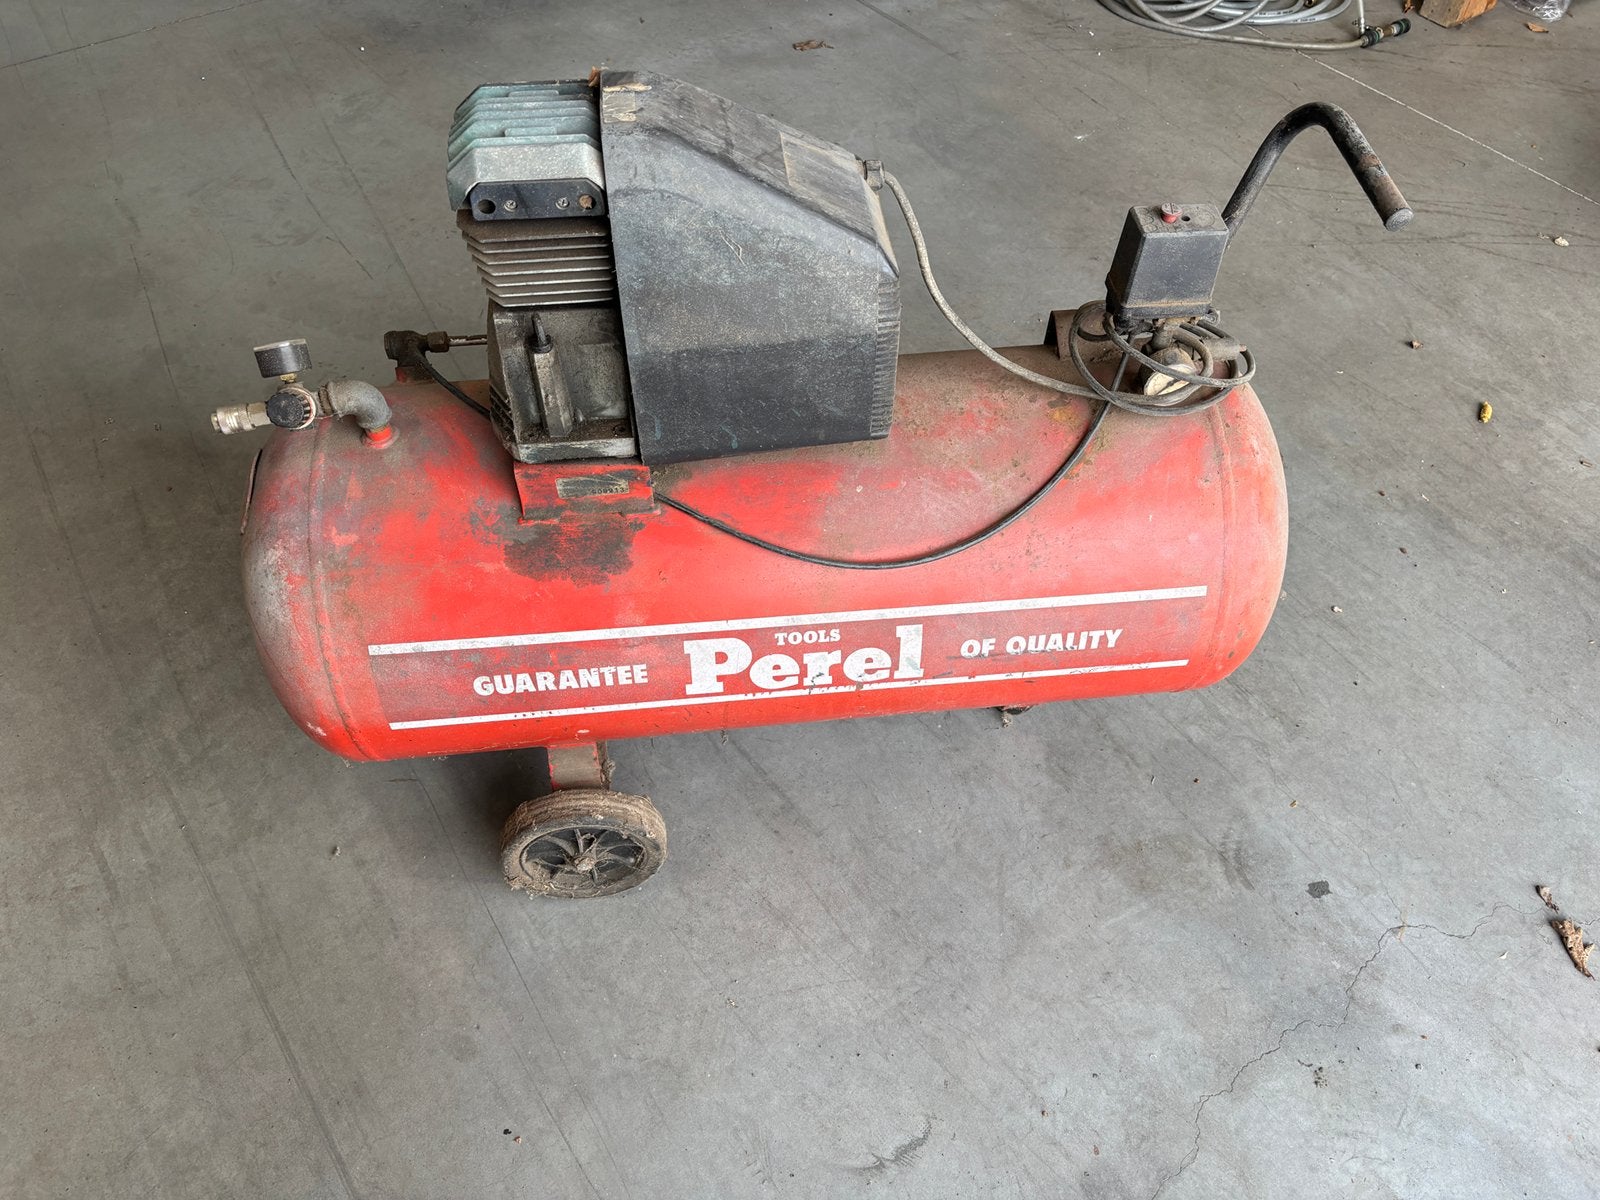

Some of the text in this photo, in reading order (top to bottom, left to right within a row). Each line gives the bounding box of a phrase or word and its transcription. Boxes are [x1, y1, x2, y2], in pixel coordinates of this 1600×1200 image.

[775, 628, 841, 647] TOOLS
[960, 628, 1123, 659] OF QUALITY
[684, 624, 924, 695] Perel
[473, 664, 649, 697] GUARANTEE
